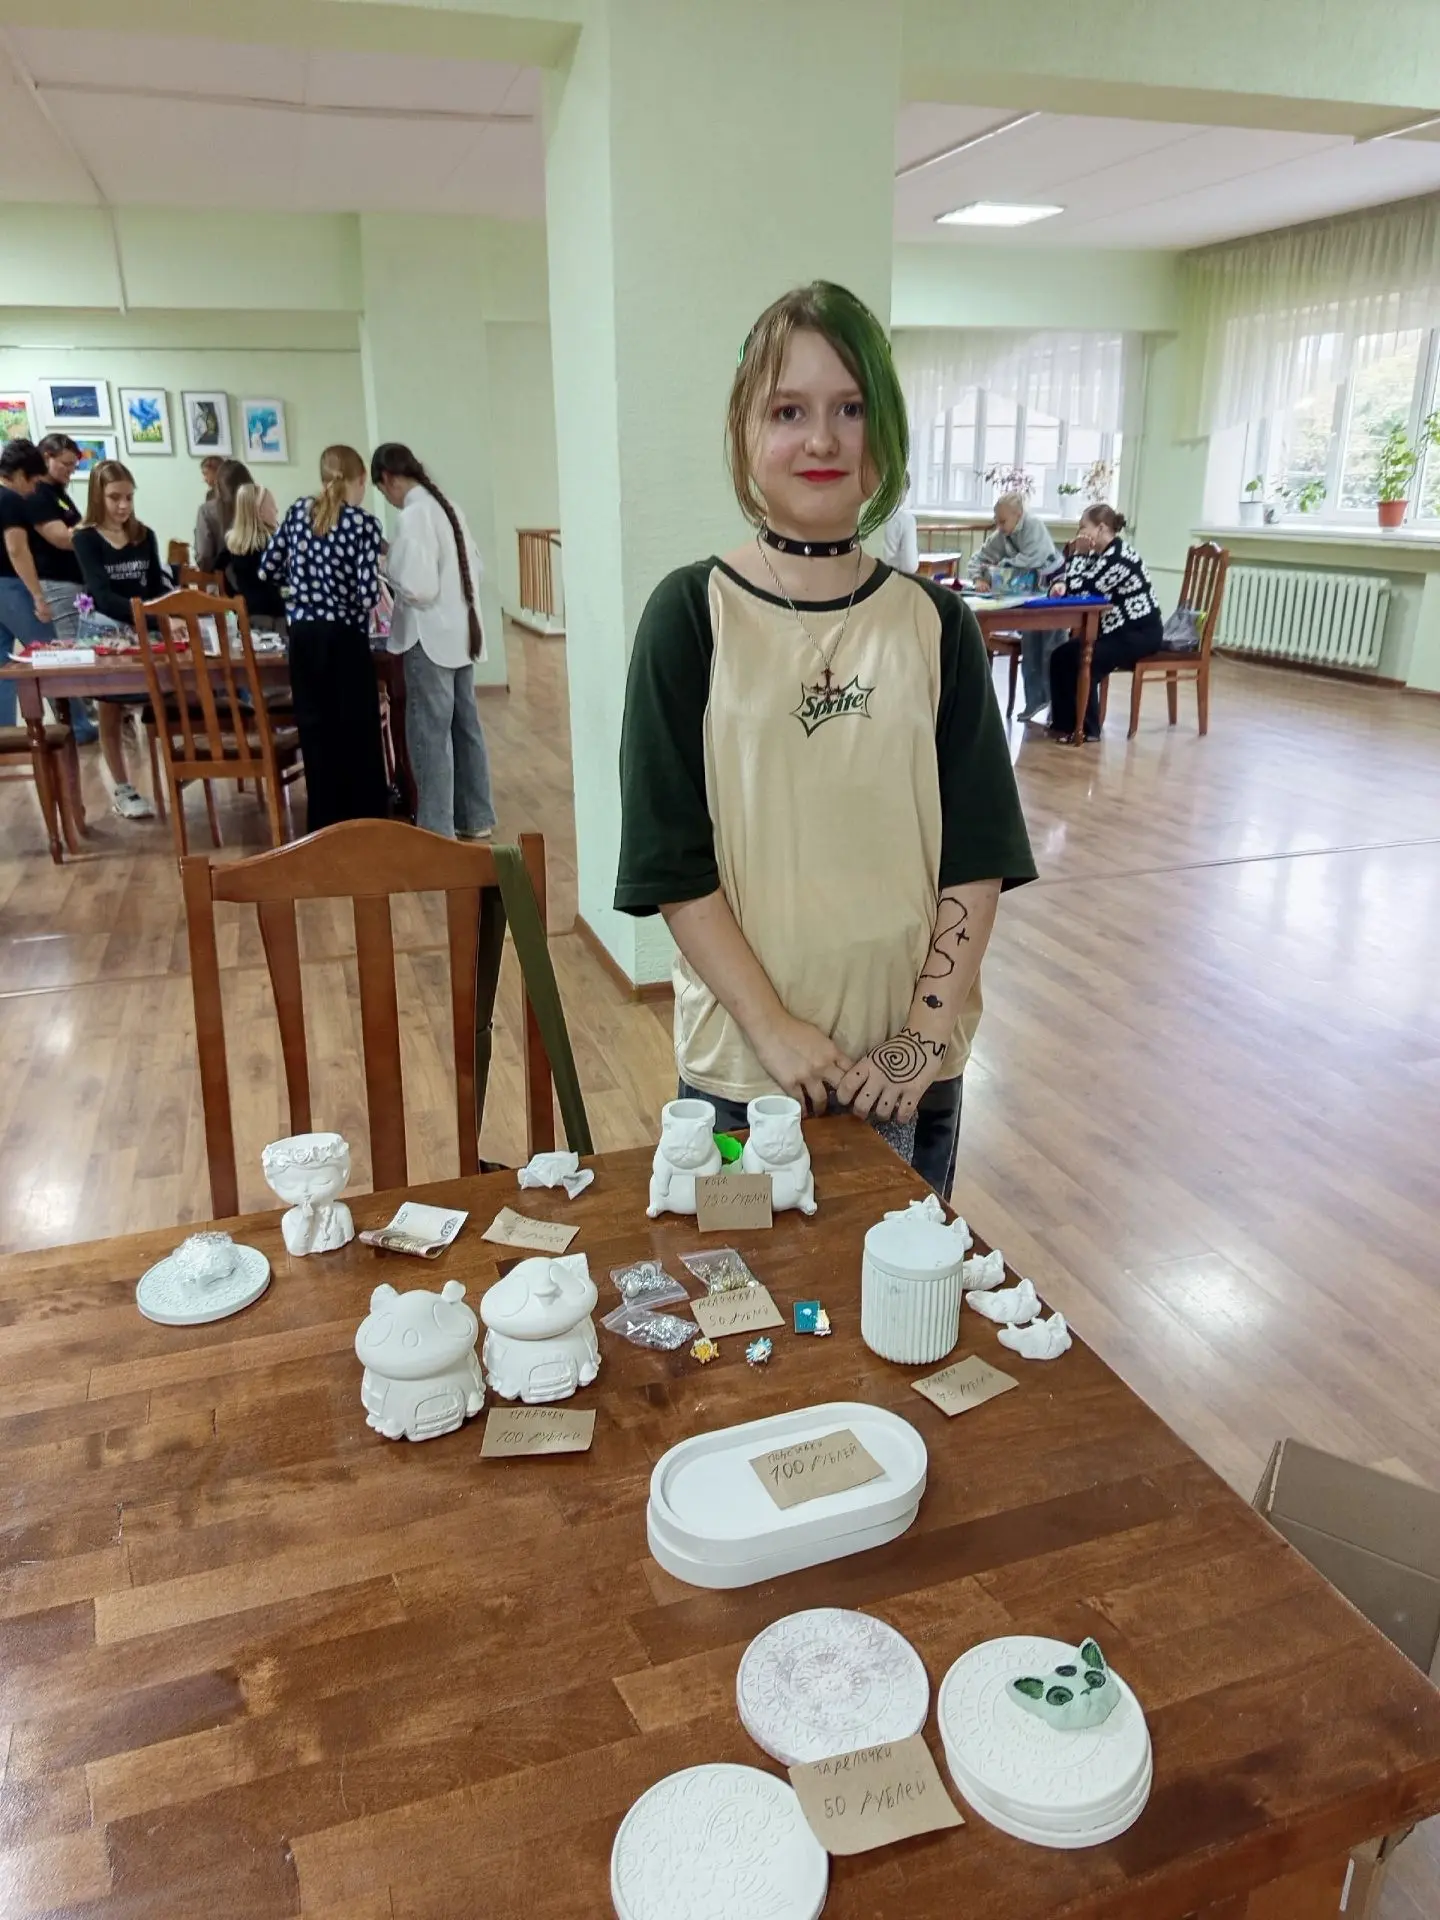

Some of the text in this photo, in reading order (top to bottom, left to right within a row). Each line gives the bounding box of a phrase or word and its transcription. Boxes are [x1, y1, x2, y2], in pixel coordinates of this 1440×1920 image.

[802, 692, 864, 720] Sprite
[769, 1459, 805, 1487] 100
[823, 1796, 847, 1819] 50
